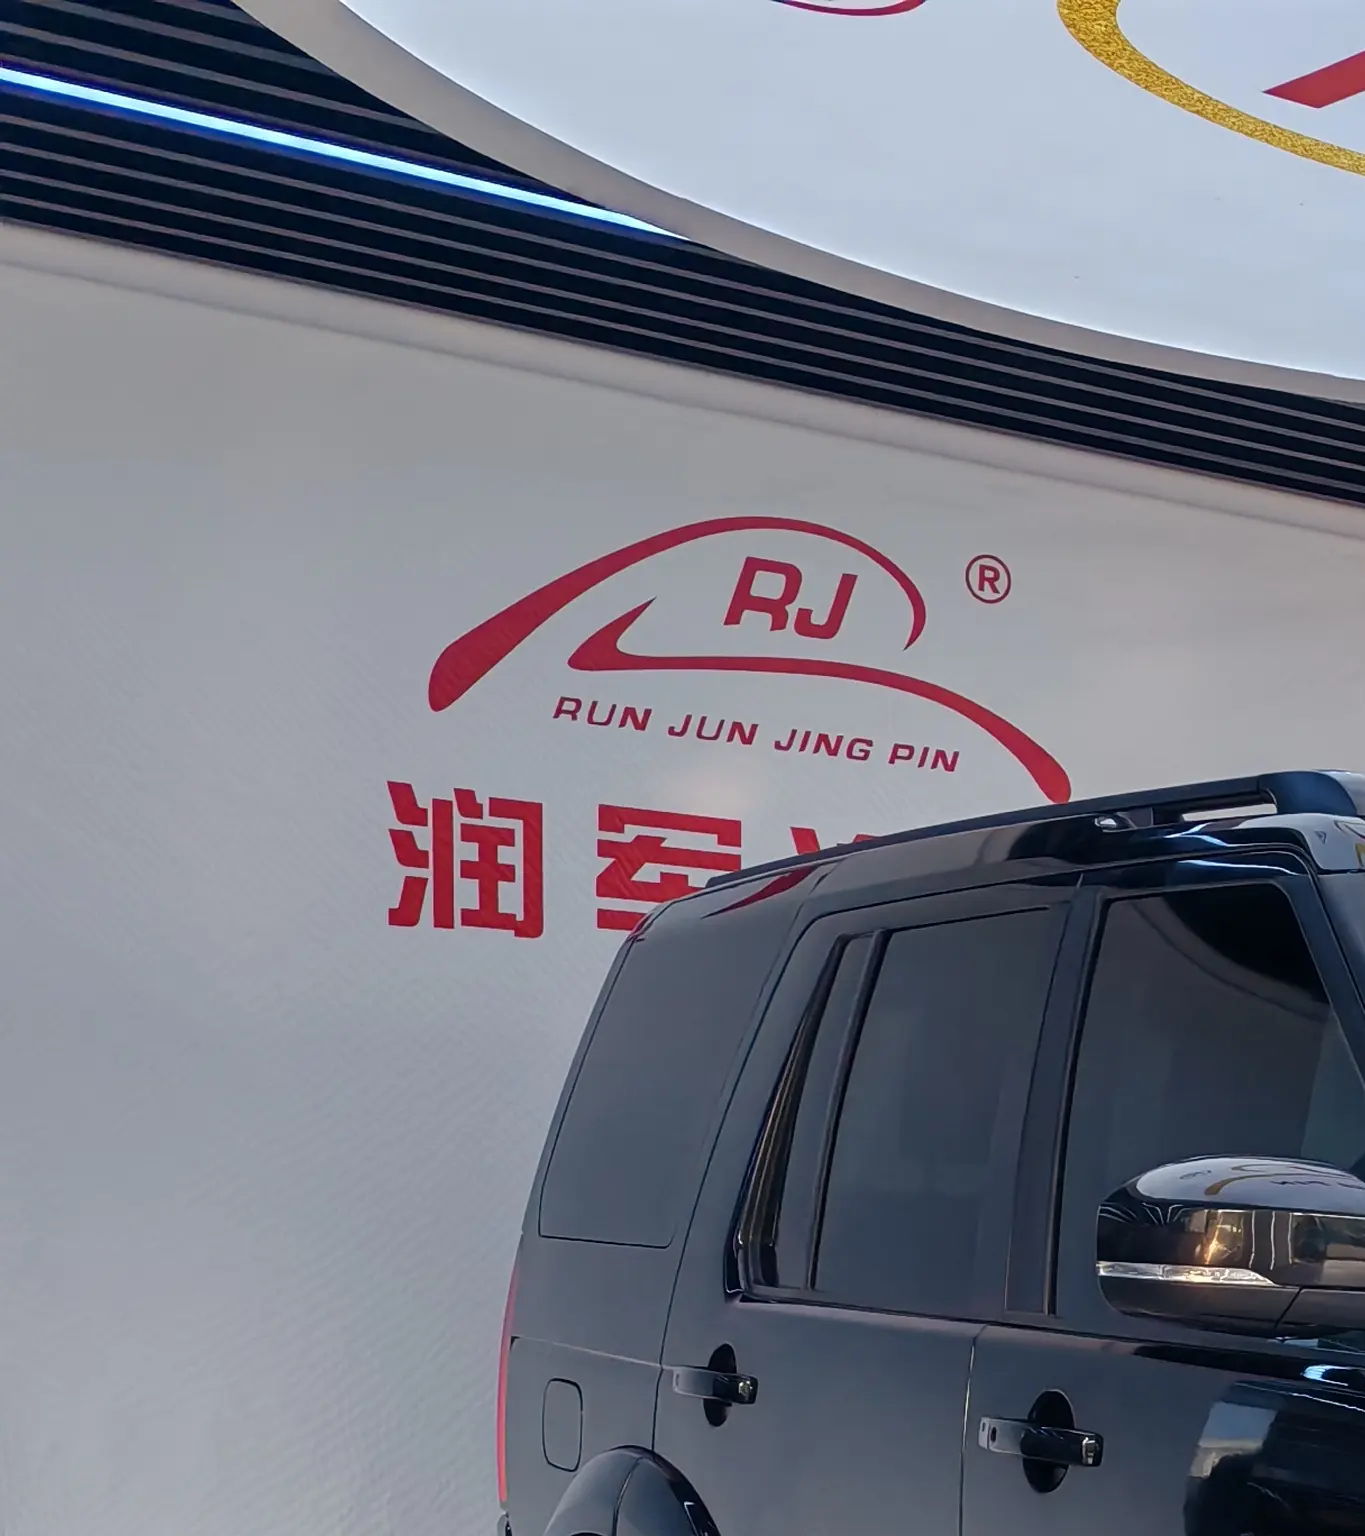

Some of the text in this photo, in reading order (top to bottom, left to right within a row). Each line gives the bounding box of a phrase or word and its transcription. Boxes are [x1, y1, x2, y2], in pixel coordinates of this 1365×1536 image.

[723, 555, 859, 640] RJ
[553, 697, 960, 773] RUN JUN JING PIN
